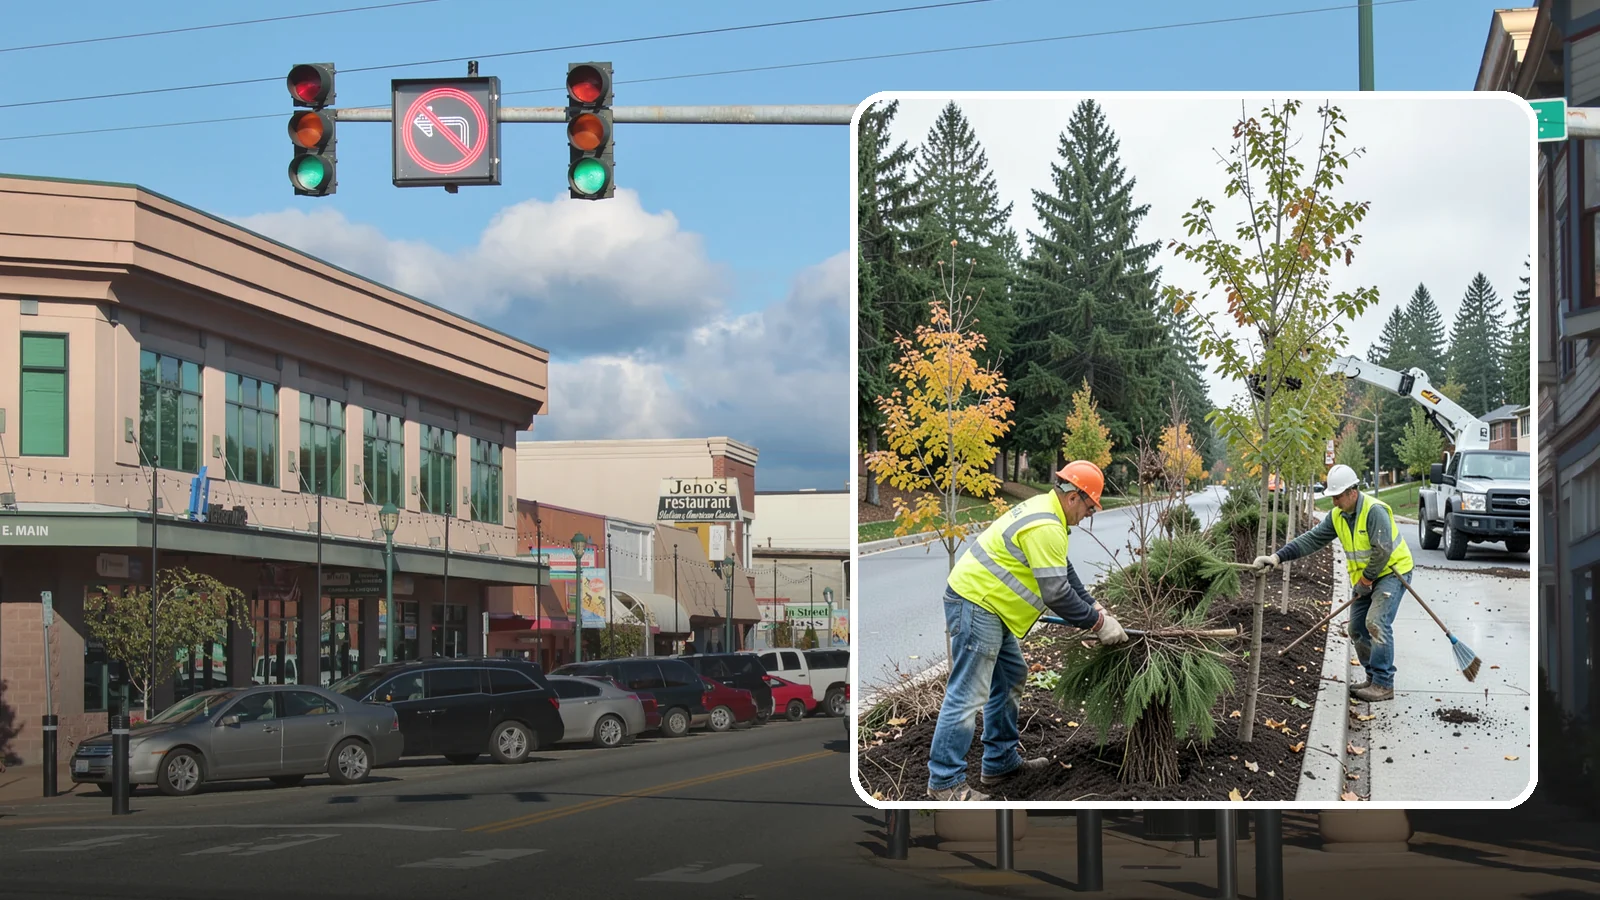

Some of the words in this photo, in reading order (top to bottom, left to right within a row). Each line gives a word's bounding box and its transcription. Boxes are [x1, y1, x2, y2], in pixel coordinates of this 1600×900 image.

[670, 480, 727, 494] Jeno's
[665, 496, 730, 508] restaurant
[658, 510, 682, 520] Italian
[686, 510, 714, 519] American
[715, 510, 736, 518] Cuisine
[2, 525, 13, 536] E.
[15, 525, 49, 536] MAIN
[797, 607, 828, 617] Street
